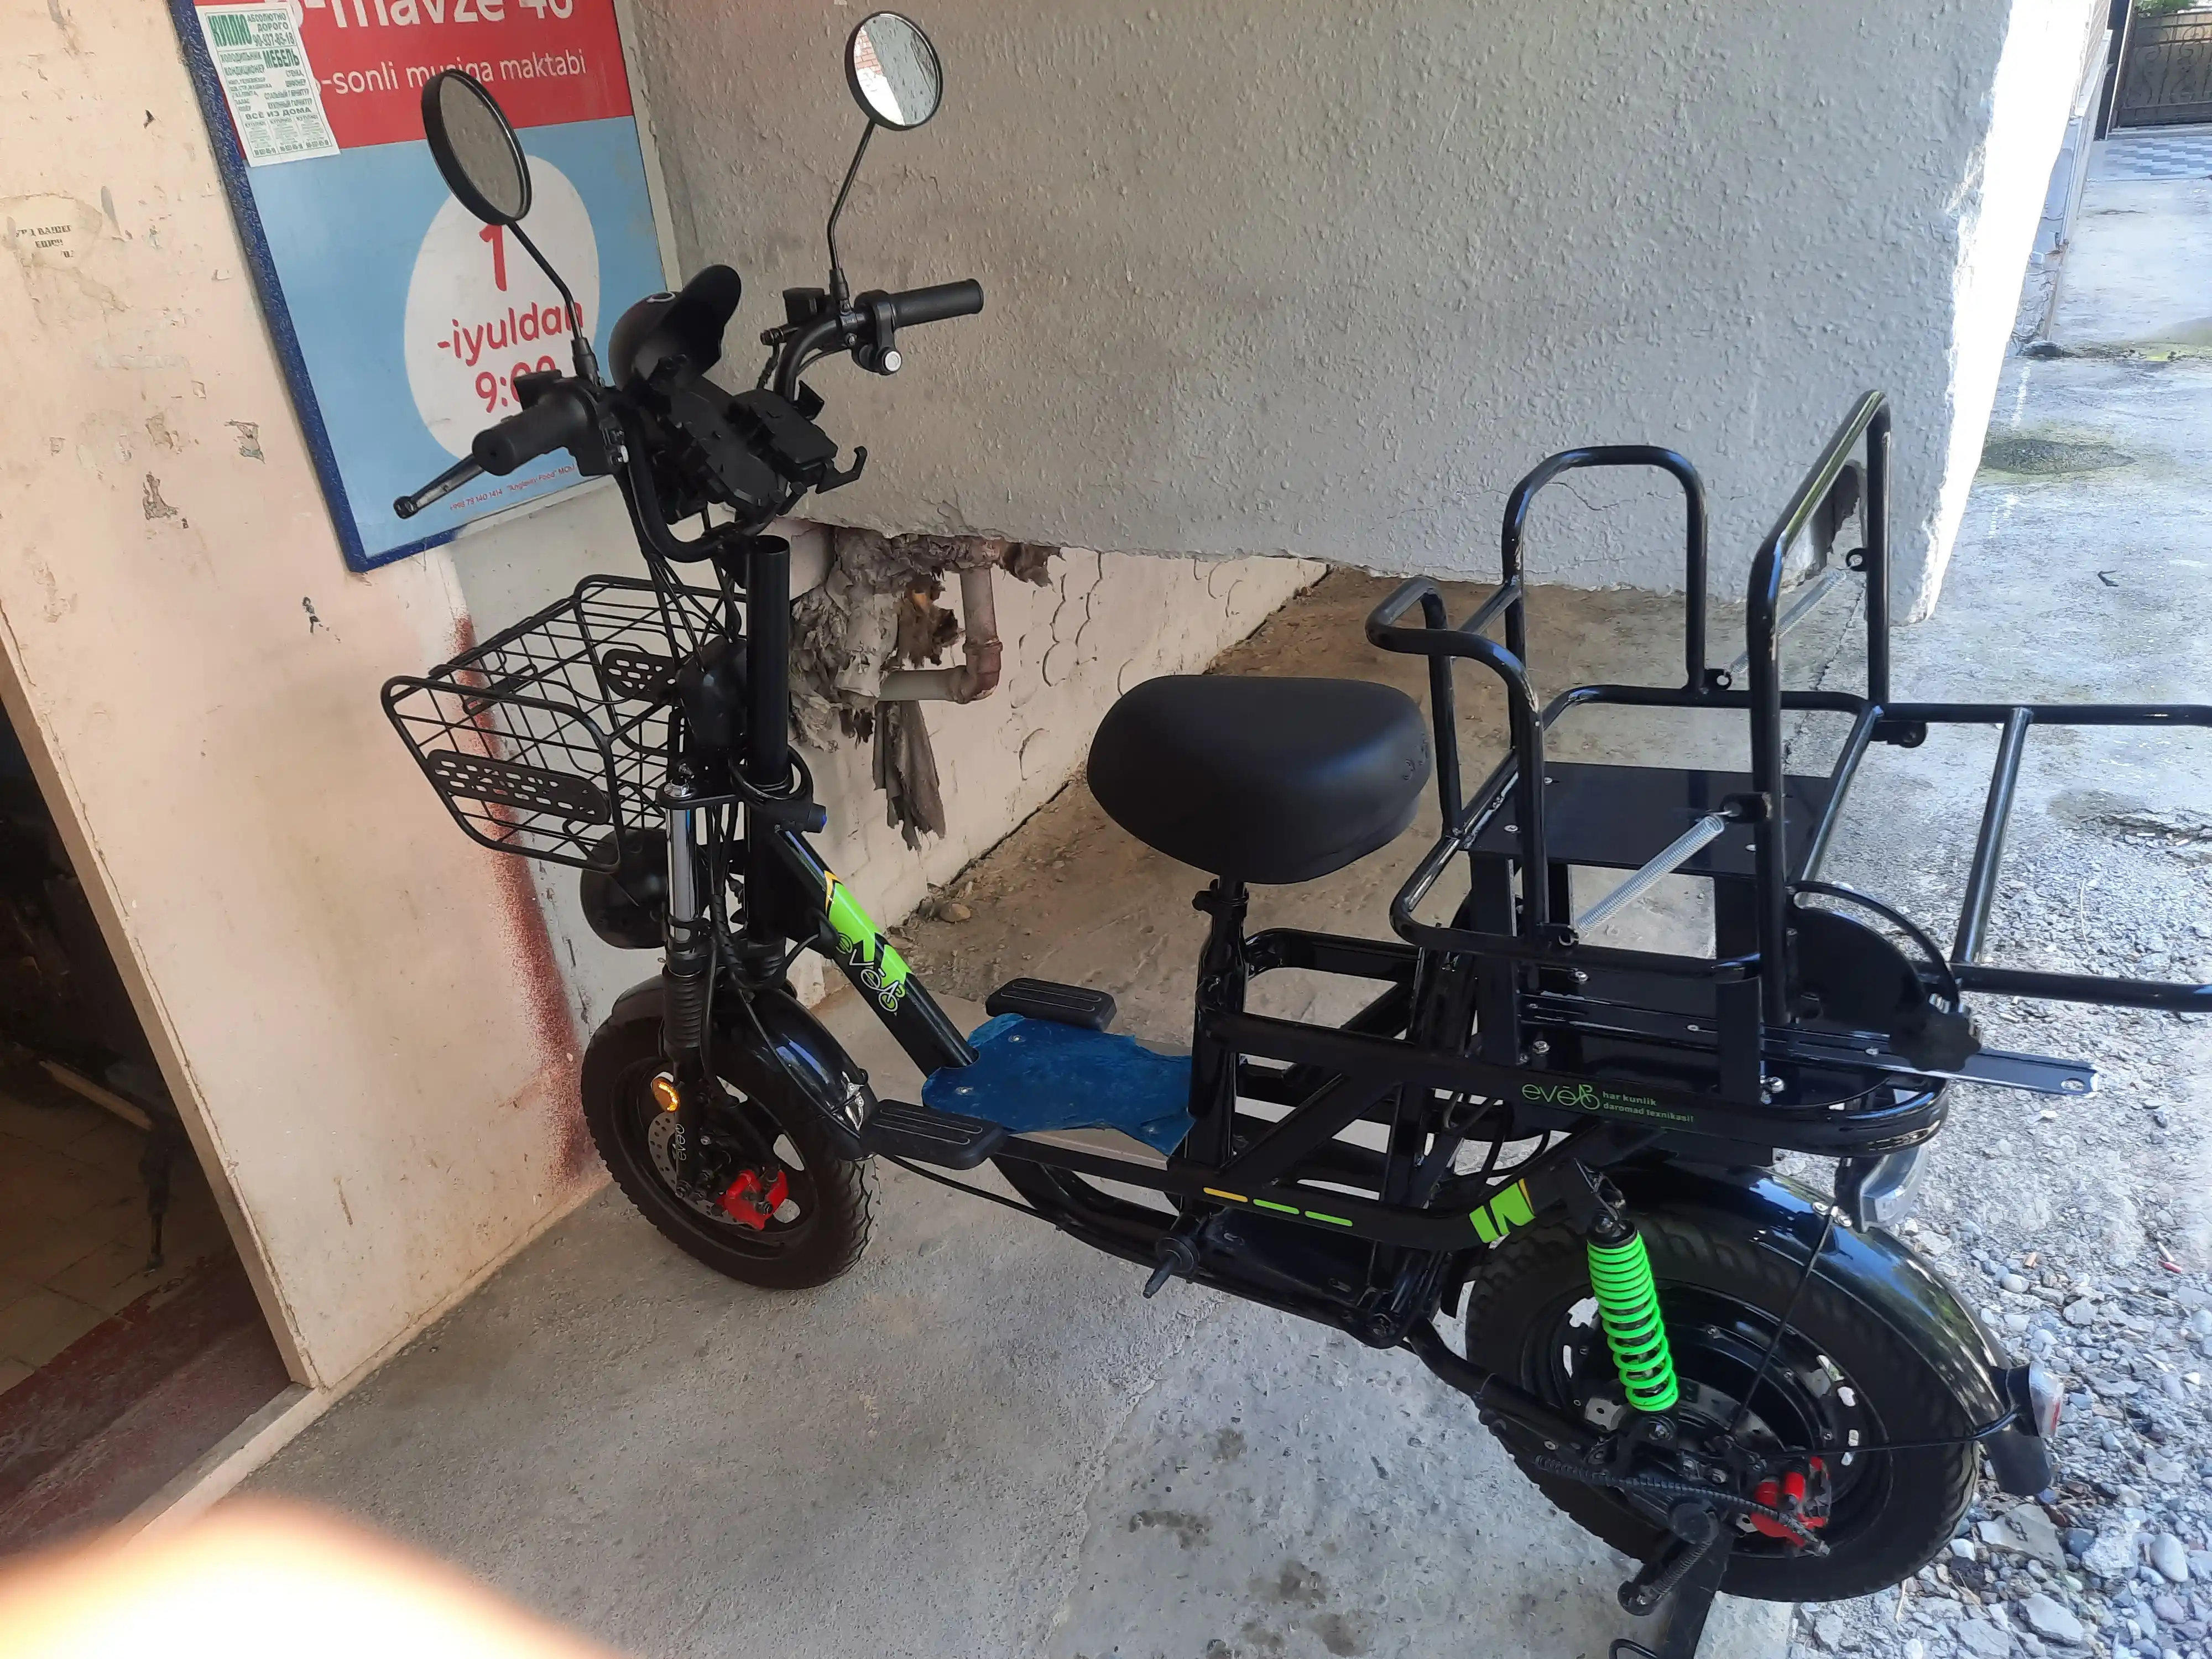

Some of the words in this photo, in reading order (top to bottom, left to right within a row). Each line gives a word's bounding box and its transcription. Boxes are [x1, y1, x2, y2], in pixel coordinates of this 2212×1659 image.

[247, 12, 286, 23] АБСОЛЮТНО
[207, 14, 253, 48] КУПЛЮ
[257, 22, 289, 33] ДОРОГО
[262, 48, 300, 69] МЕБЕЛЬ
[499, 48, 586, 80] maktabi
[283, 107, 312, 117] ДОМА
[479, 225, 507, 291] 1
[1602, 1091, 1621, 1100] har
[1623, 1094, 1657, 1106] kunlik
[1603, 1102, 1644, 1115] daromad
